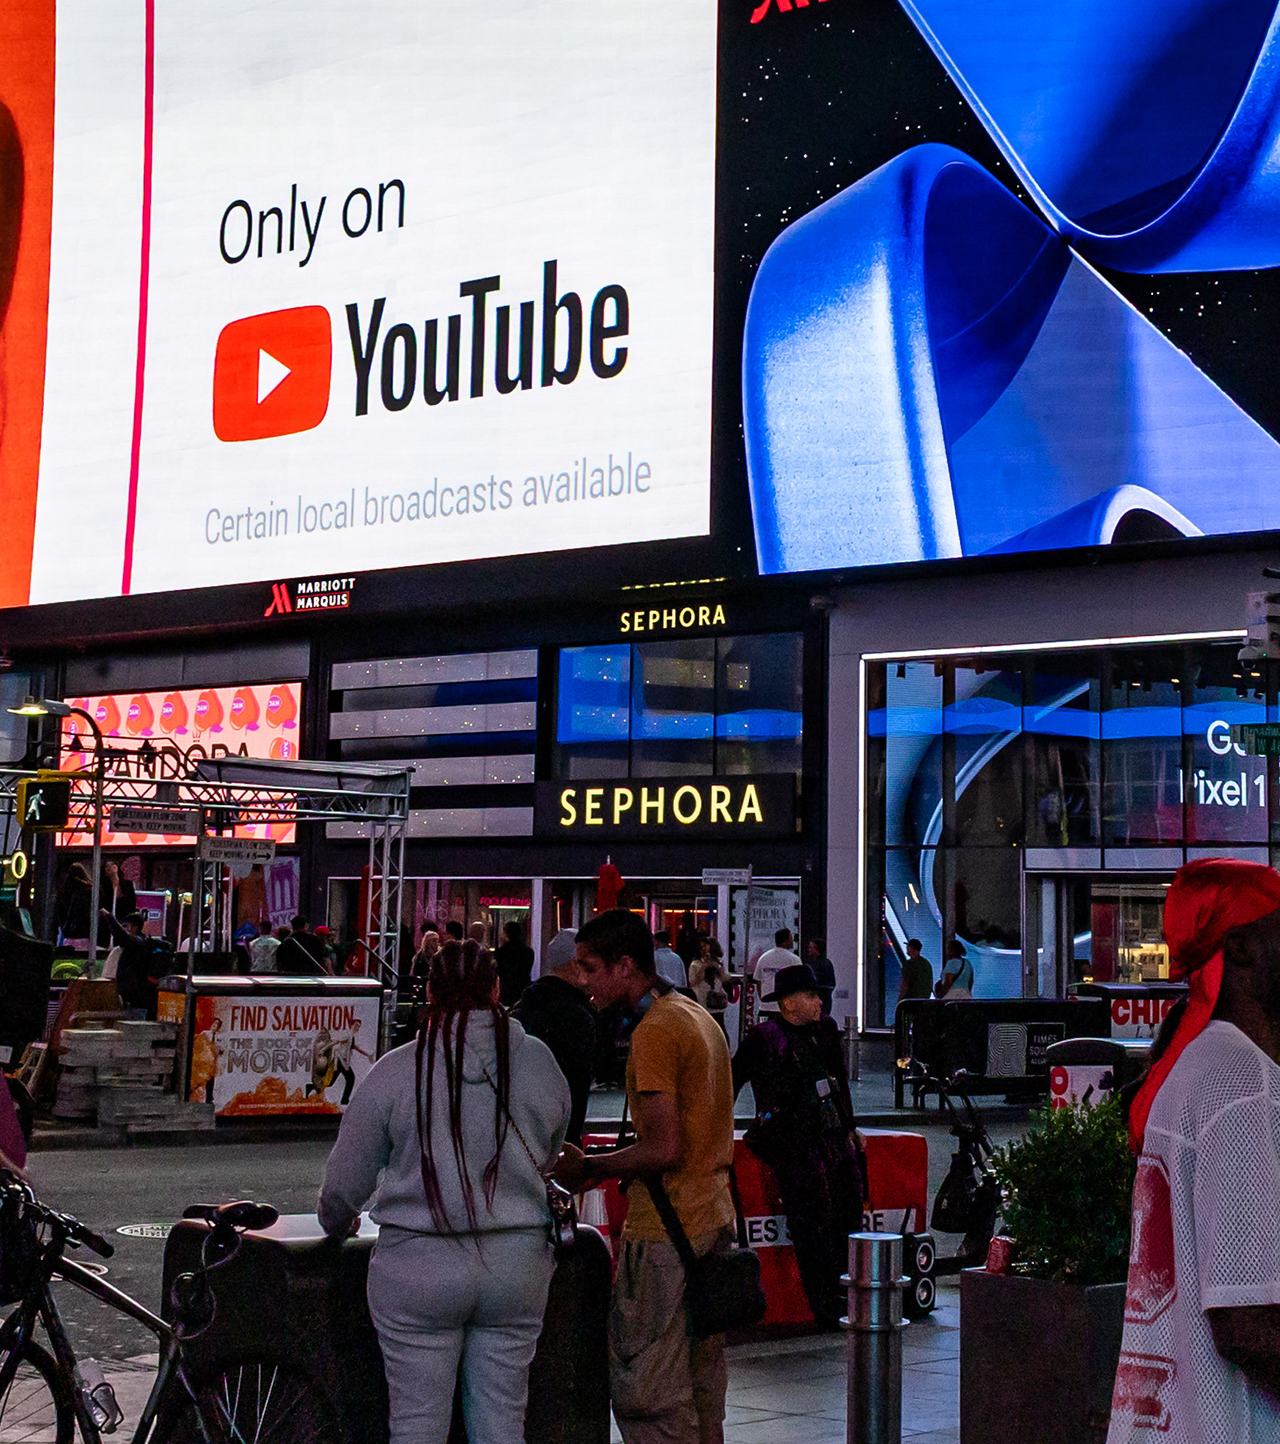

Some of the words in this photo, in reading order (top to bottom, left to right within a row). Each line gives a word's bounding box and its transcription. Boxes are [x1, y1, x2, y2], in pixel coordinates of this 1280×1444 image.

[219, 182, 327, 268] Only
[341, 178, 406, 239] on
[345, 259, 631, 417] YouTube
[204, 500, 288, 545] Certain
[296, 487, 356, 534] local
[363, 473, 513, 527] broadcasts
[522, 451, 652, 507] available
[297, 578, 356, 594] MARRIOTT
[297, 594, 348, 609] MARQUIS
[620, 604, 726, 633] SEPHORA
[560, 784, 764, 826] SEPHORA
[113, 809, 151, 821] PEDESTRIAN
[153, 811, 169, 821] FLOW
[170, 812, 187, 822] ZONE
[146, 822, 161, 831] KEEP
[162, 822, 187, 832] MOVING
[210, 840, 242, 850] PEDESTRIAN
[230, 1005, 268, 1031] FIND
[272, 1005, 354, 1031] SALVATION
[229, 1038, 253, 1049] THE
[257, 1038, 292, 1049] BOOK
[295, 1038, 314, 1049] OF
[1033, 1035, 1057, 1044] TIMES
